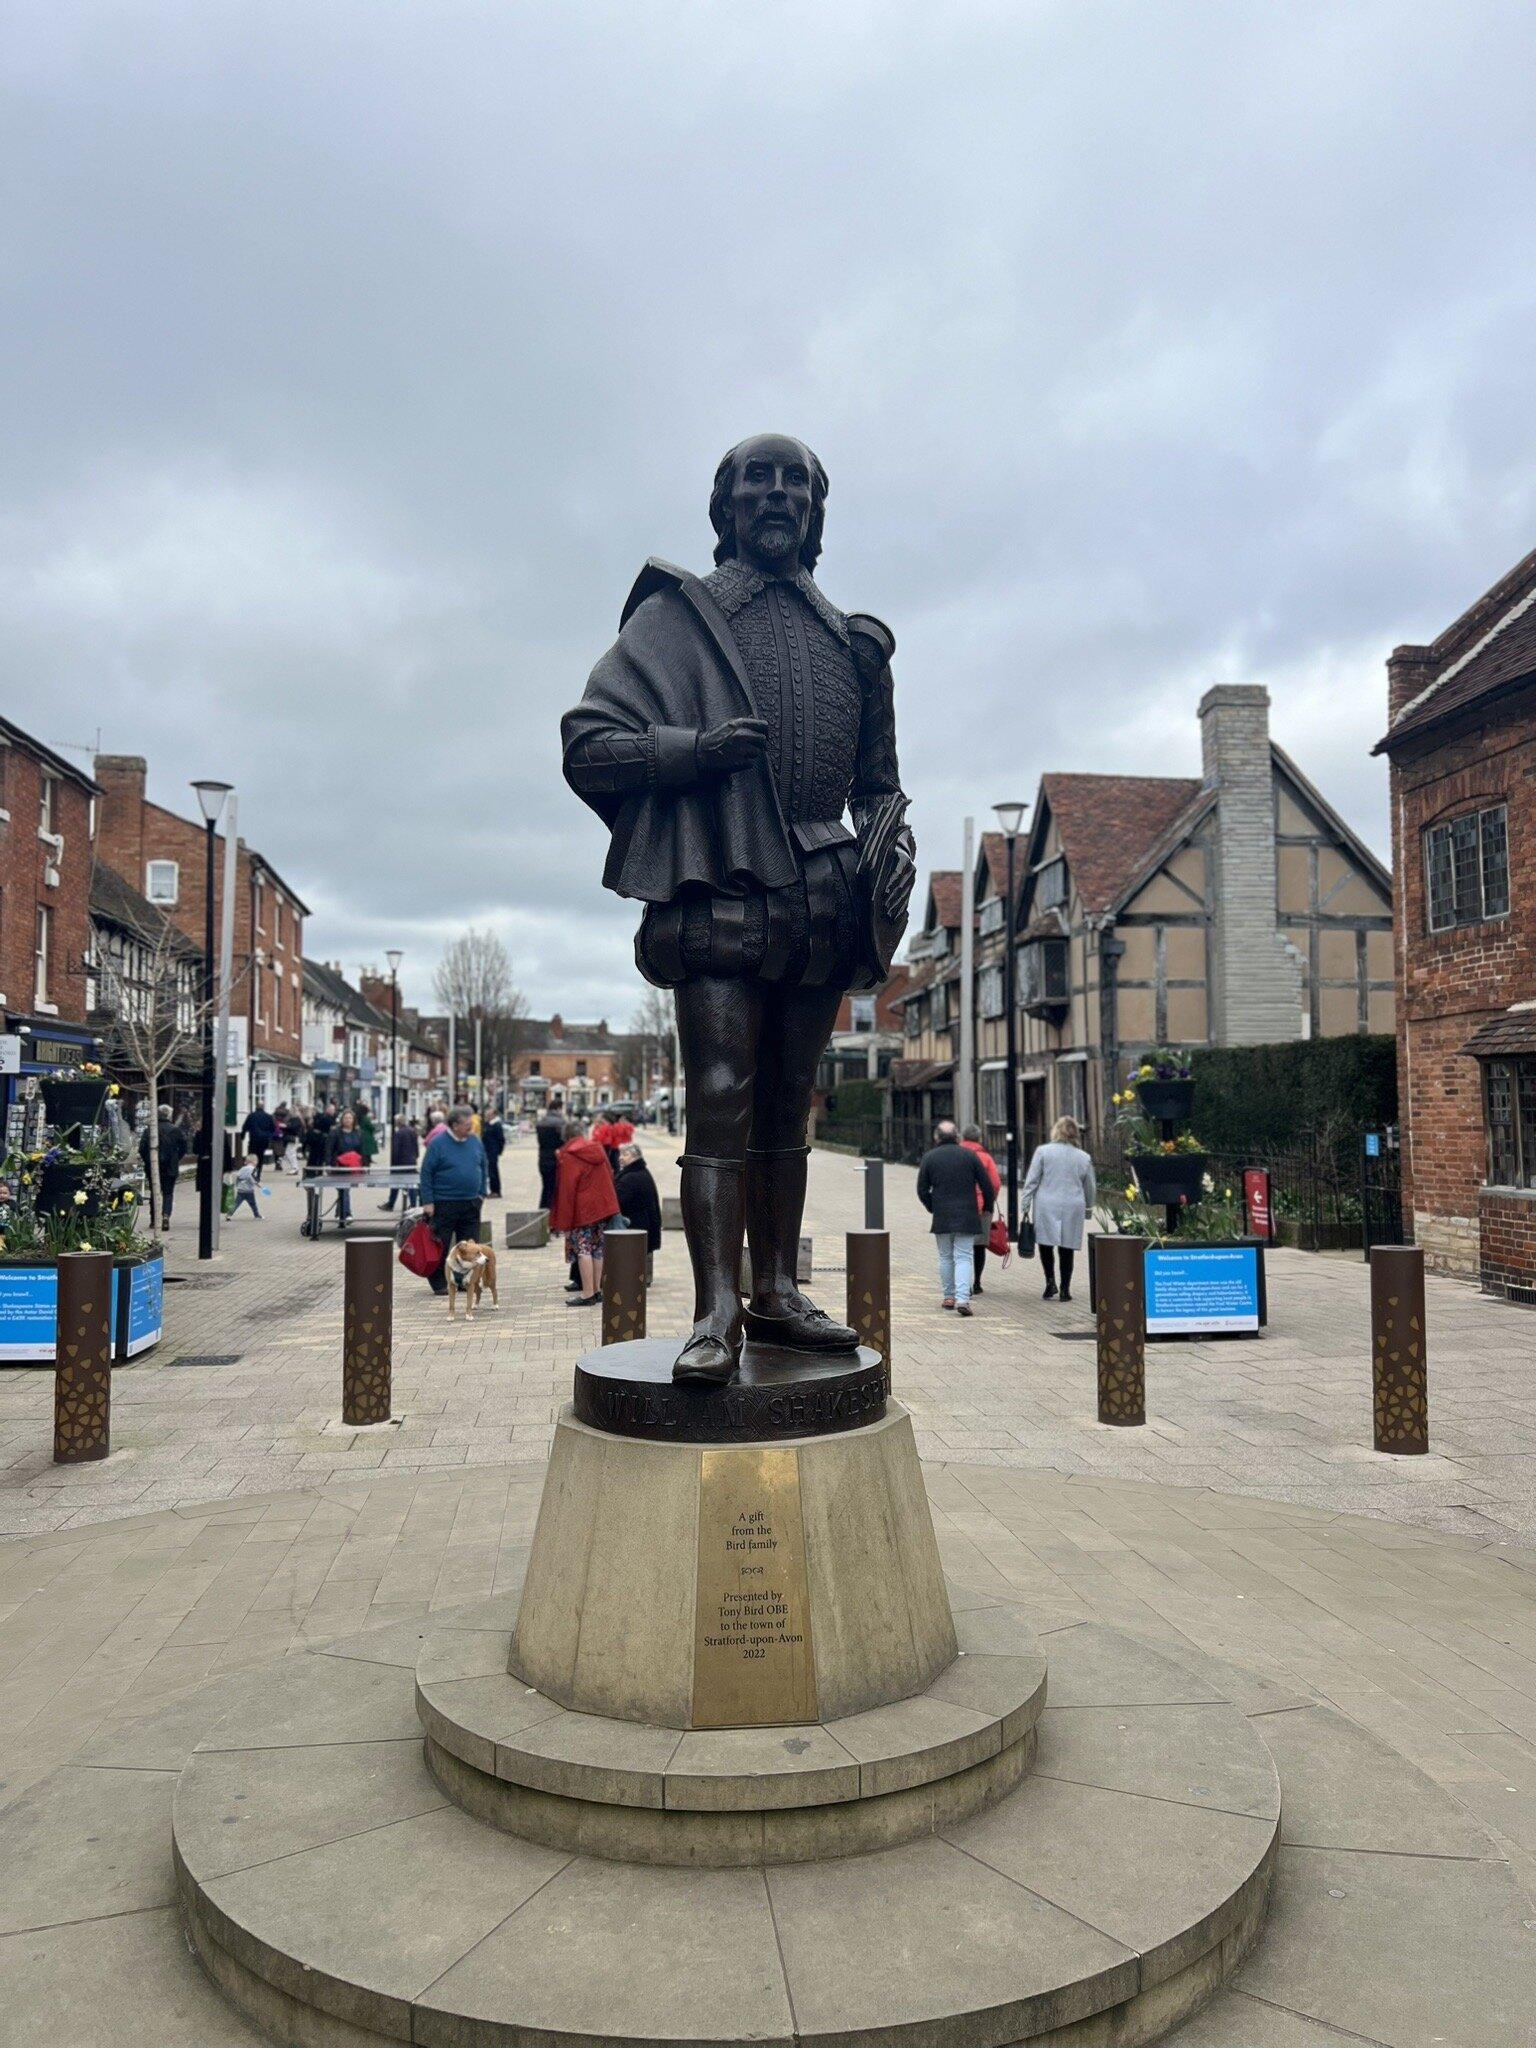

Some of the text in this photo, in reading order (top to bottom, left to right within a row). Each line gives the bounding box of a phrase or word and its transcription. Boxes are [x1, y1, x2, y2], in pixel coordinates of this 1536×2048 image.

[739, 1511, 764, 1523] A gift
[732, 1525, 771, 1536] from the
[726, 1539, 777, 1554] Bird family
[723, 1591, 783, 1603] Presented by
[718, 1605, 789, 1619] Tony Bird OBE
[721, 1619, 787, 1631] to the town of
[704, 1634, 803, 1647] Stratford-upon-Avon
[742, 1649, 766, 1659] 2022
